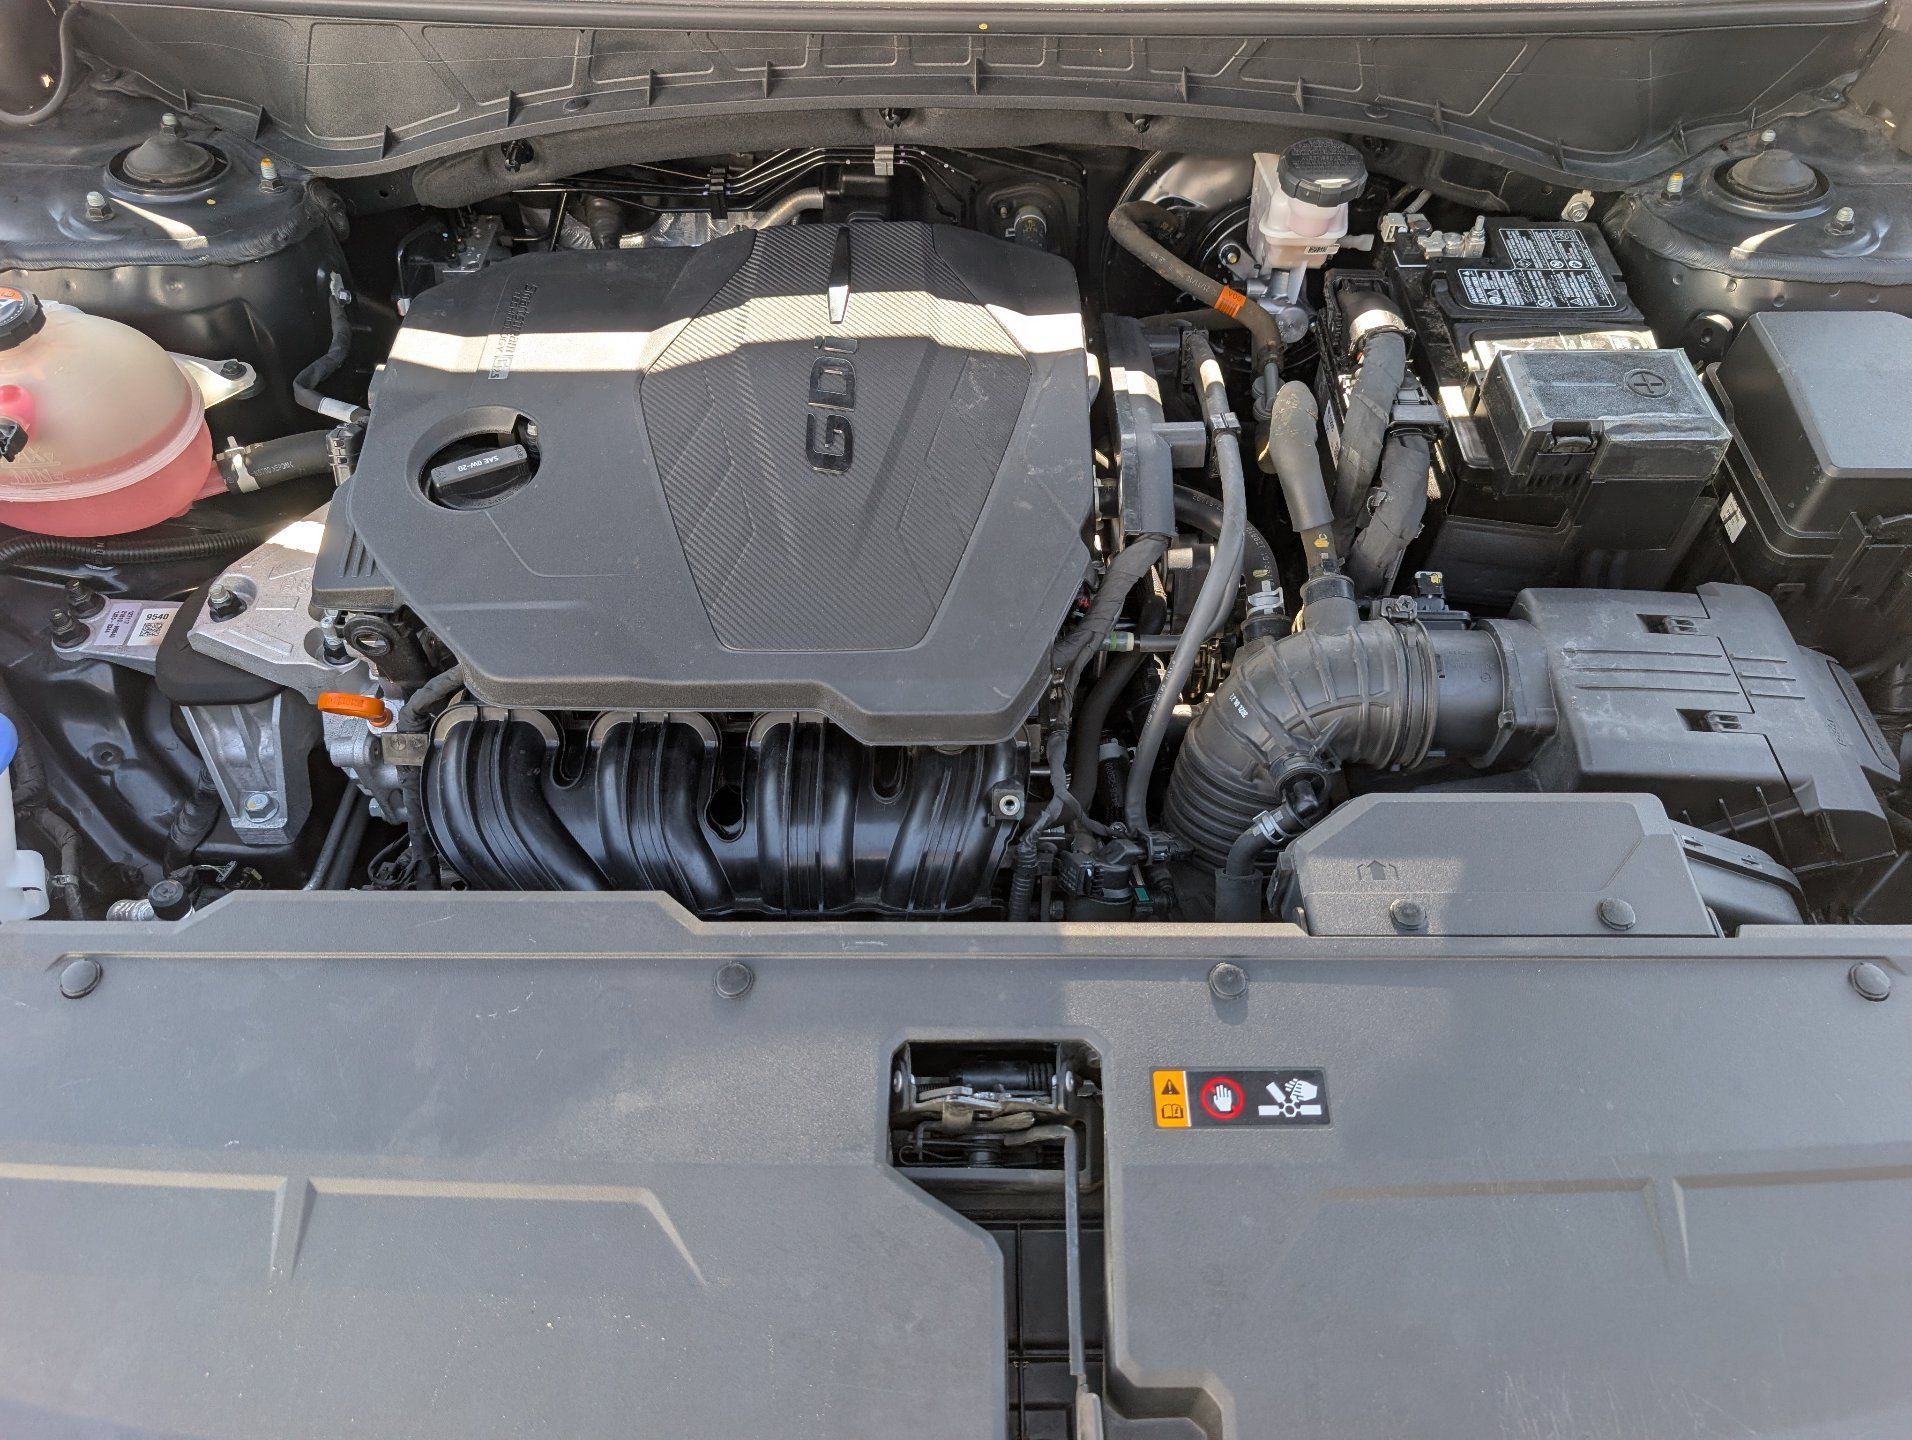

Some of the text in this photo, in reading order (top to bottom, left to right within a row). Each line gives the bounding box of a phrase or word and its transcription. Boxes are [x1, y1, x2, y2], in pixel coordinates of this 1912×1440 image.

[806, 335, 858, 474] GDi
[457, 455, 499, 472] SAE 0W-20
[145, 613, 170, 621] 9540
